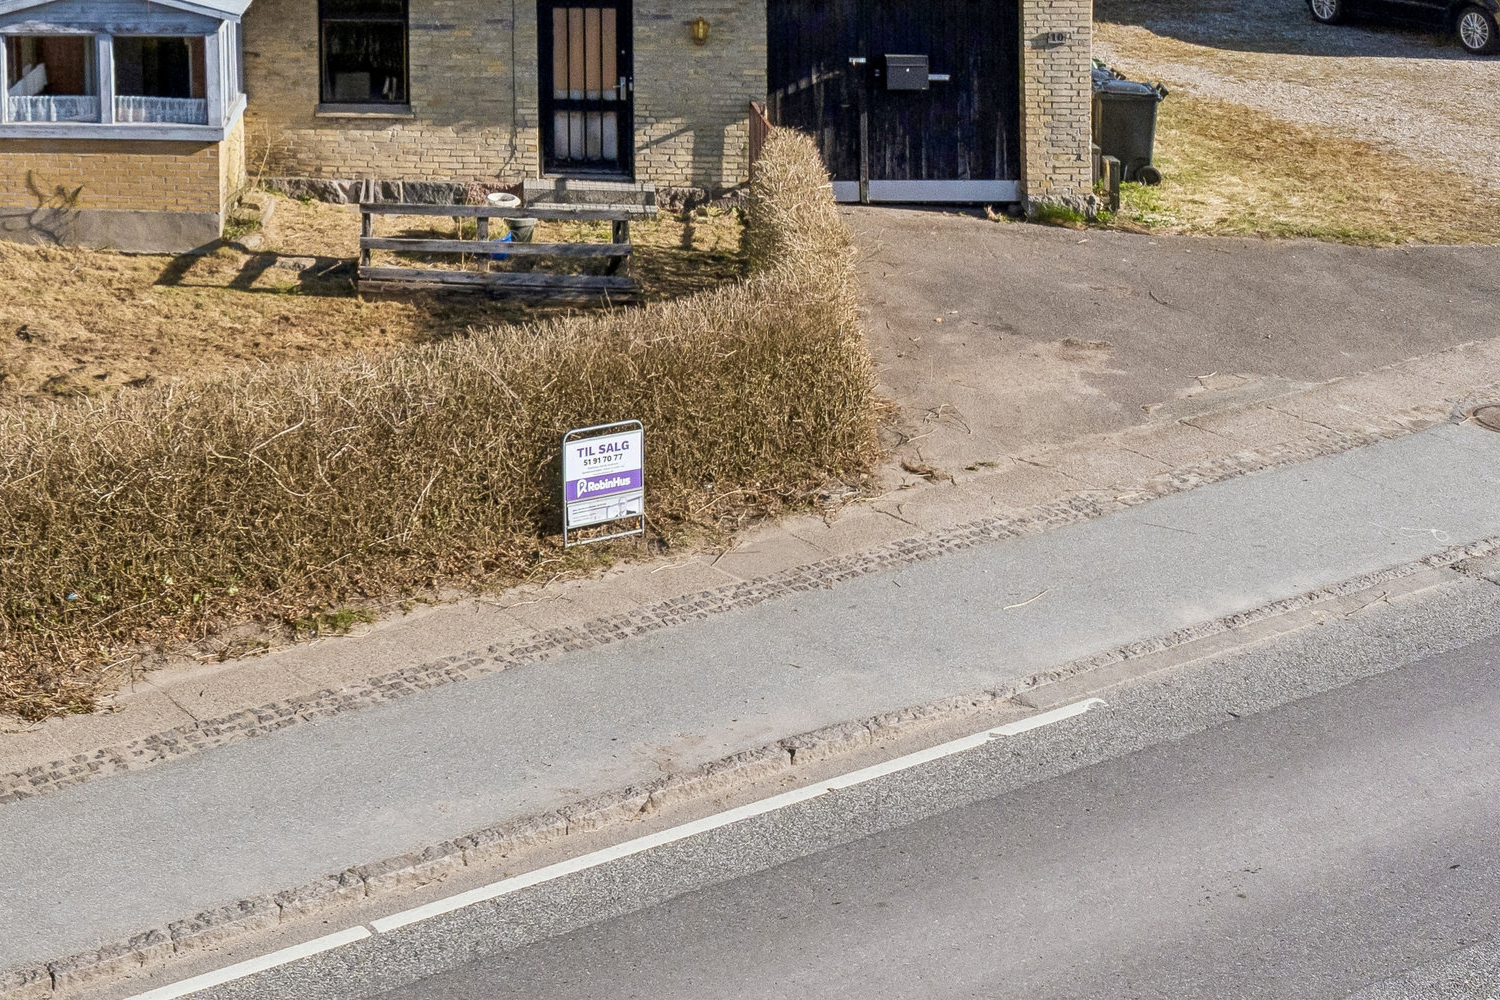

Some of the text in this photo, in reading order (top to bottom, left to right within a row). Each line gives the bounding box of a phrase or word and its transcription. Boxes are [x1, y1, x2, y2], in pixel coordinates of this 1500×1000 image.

[1051, 32, 1064, 41] 10
[577, 441, 629, 457] TIL SALG
[613, 453, 623, 461] 77
[588, 477, 630, 491] RobinHus
